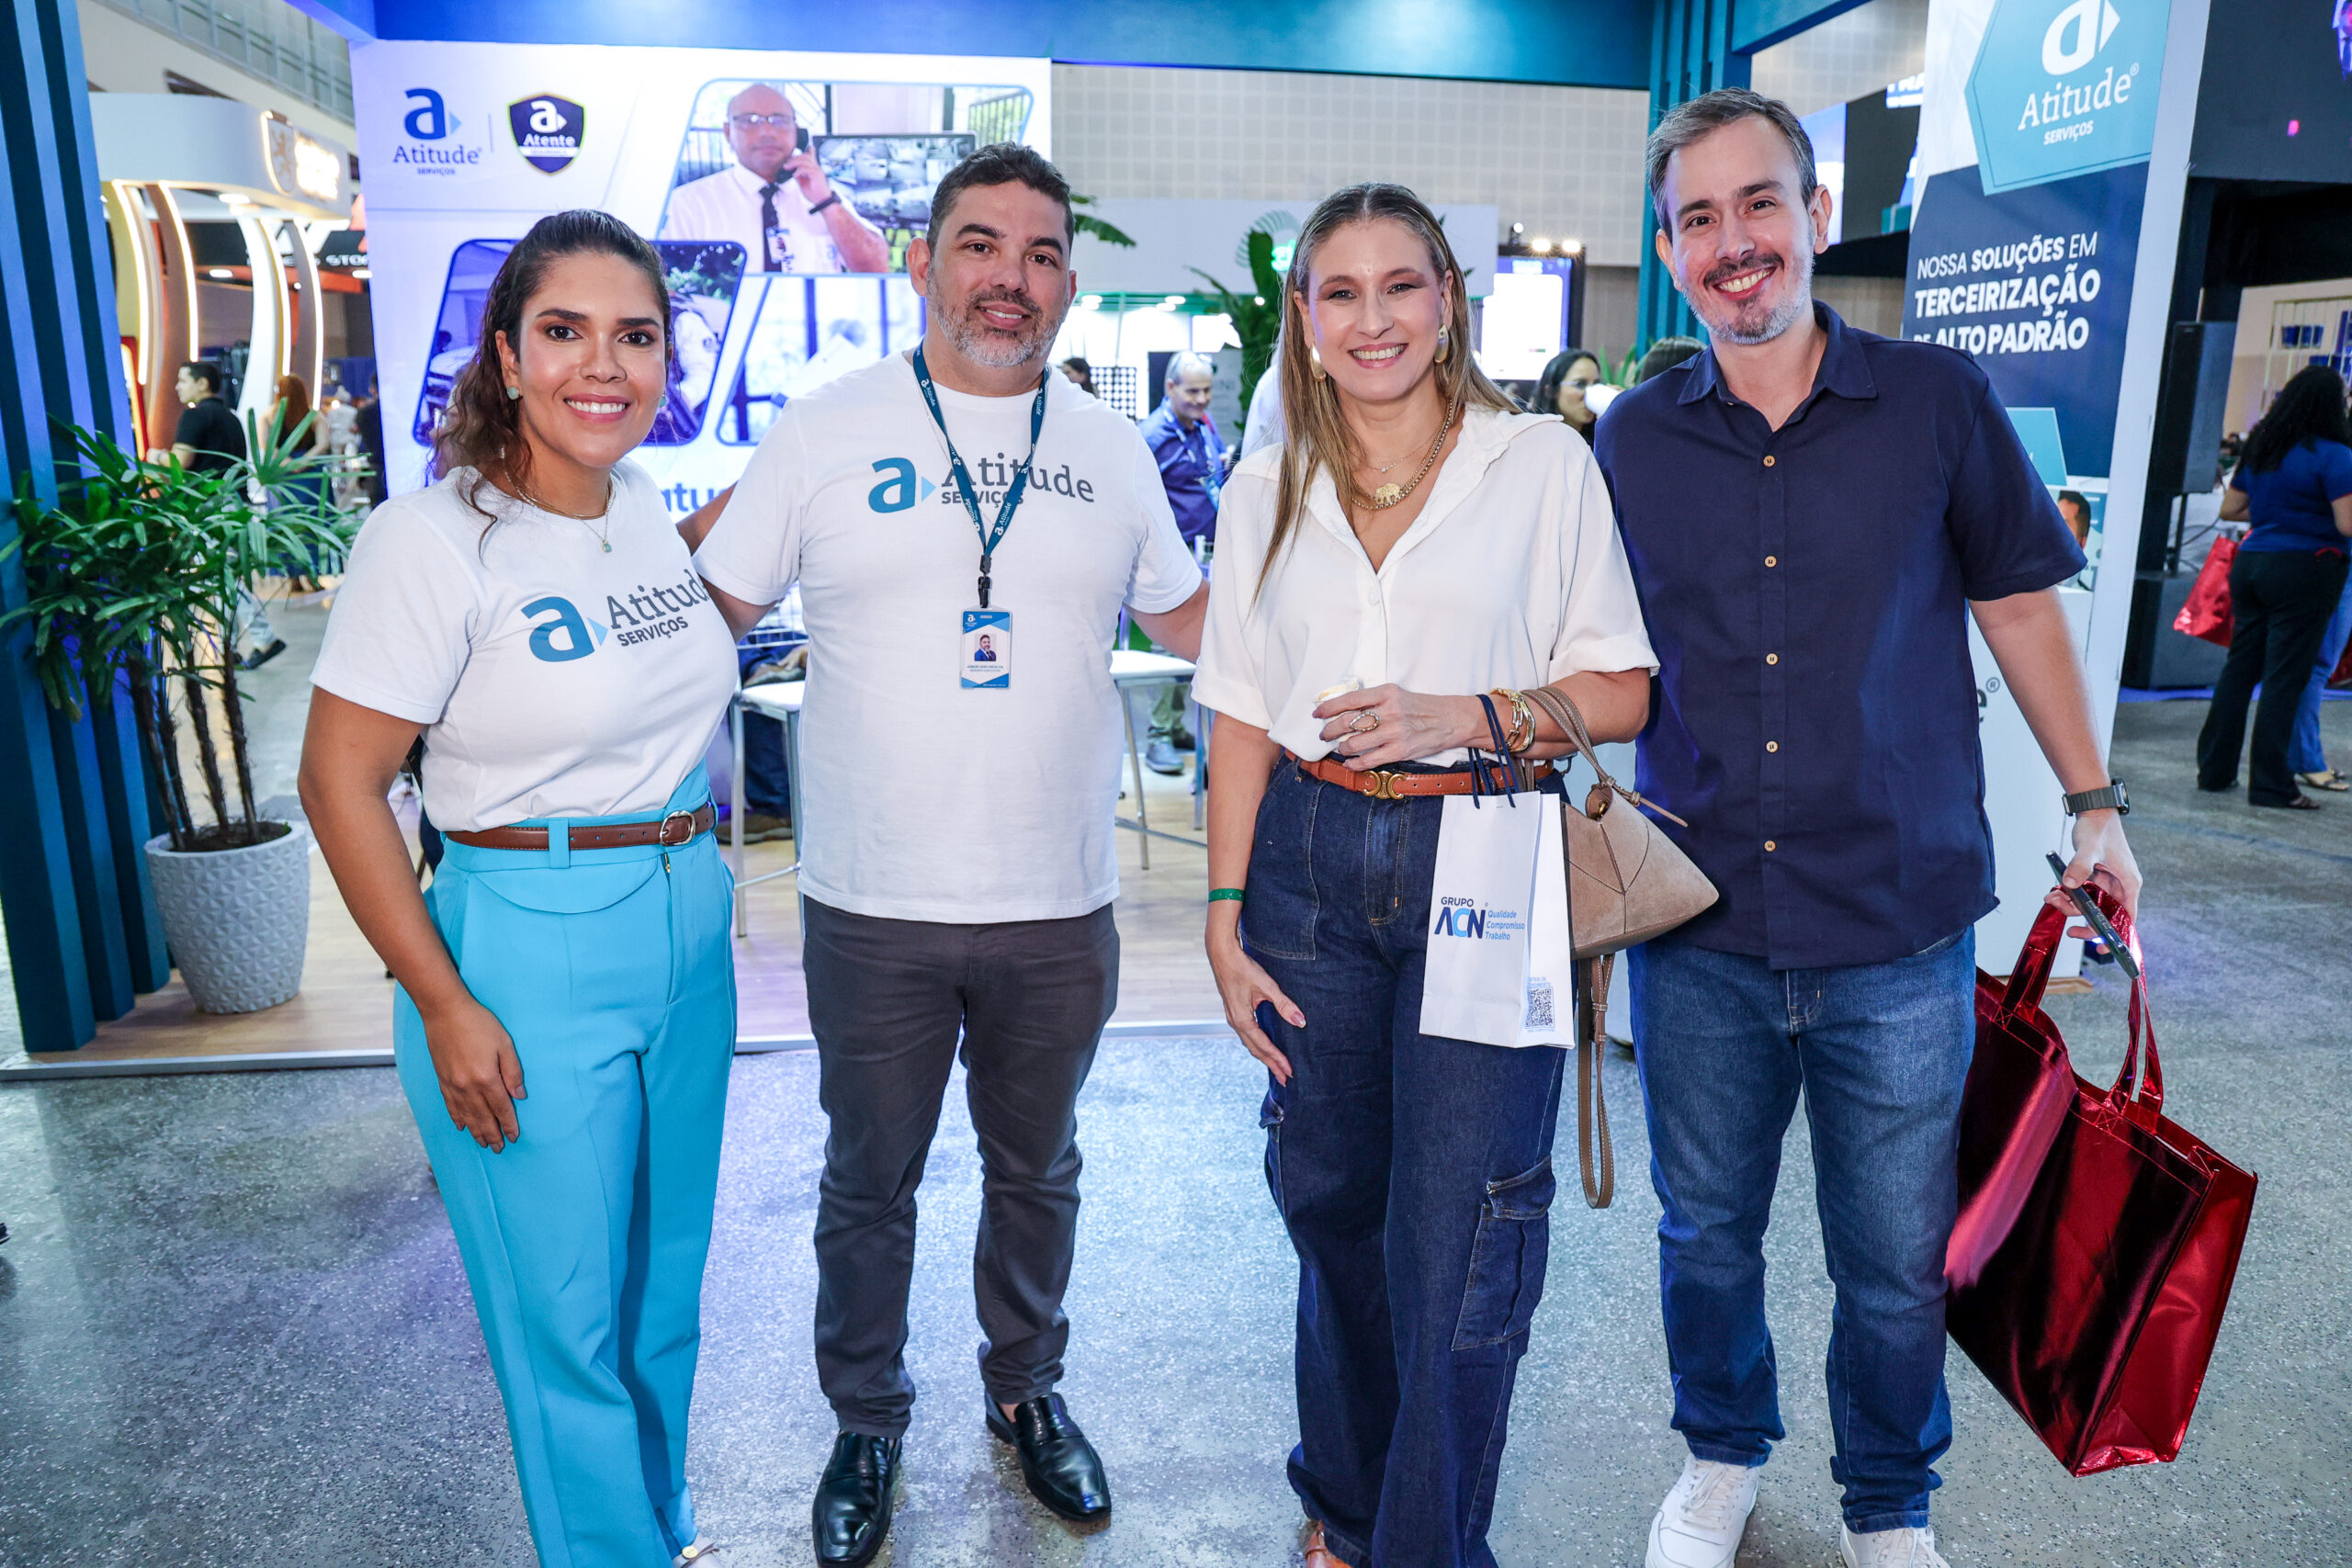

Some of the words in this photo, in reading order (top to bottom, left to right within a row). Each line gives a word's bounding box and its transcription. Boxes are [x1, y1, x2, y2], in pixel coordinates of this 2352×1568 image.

[523, 133, 575, 147] Atente
[2043, 119, 2095, 145] SERVIÇOS
[1917, 252, 1967, 280] NOSSA
[1971, 234, 2065, 274] SOLUÇÕES
[2068, 231, 2098, 259] EM
[1914, 263, 2102, 319] TERCEIRIZAÇÃO
[941, 491, 1023, 508] SEVIÇ
[606, 569, 711, 630] Atitud
[616, 616, 689, 647] SERVIÇOS
[1441, 897, 1475, 908] GRUPO
[1434, 907, 1487, 939] ACN
[1487, 910, 1517, 919] Qualidade
[1486, 920, 1525, 931] Compromisso
[1486, 931, 1510, 941] Trabalho
